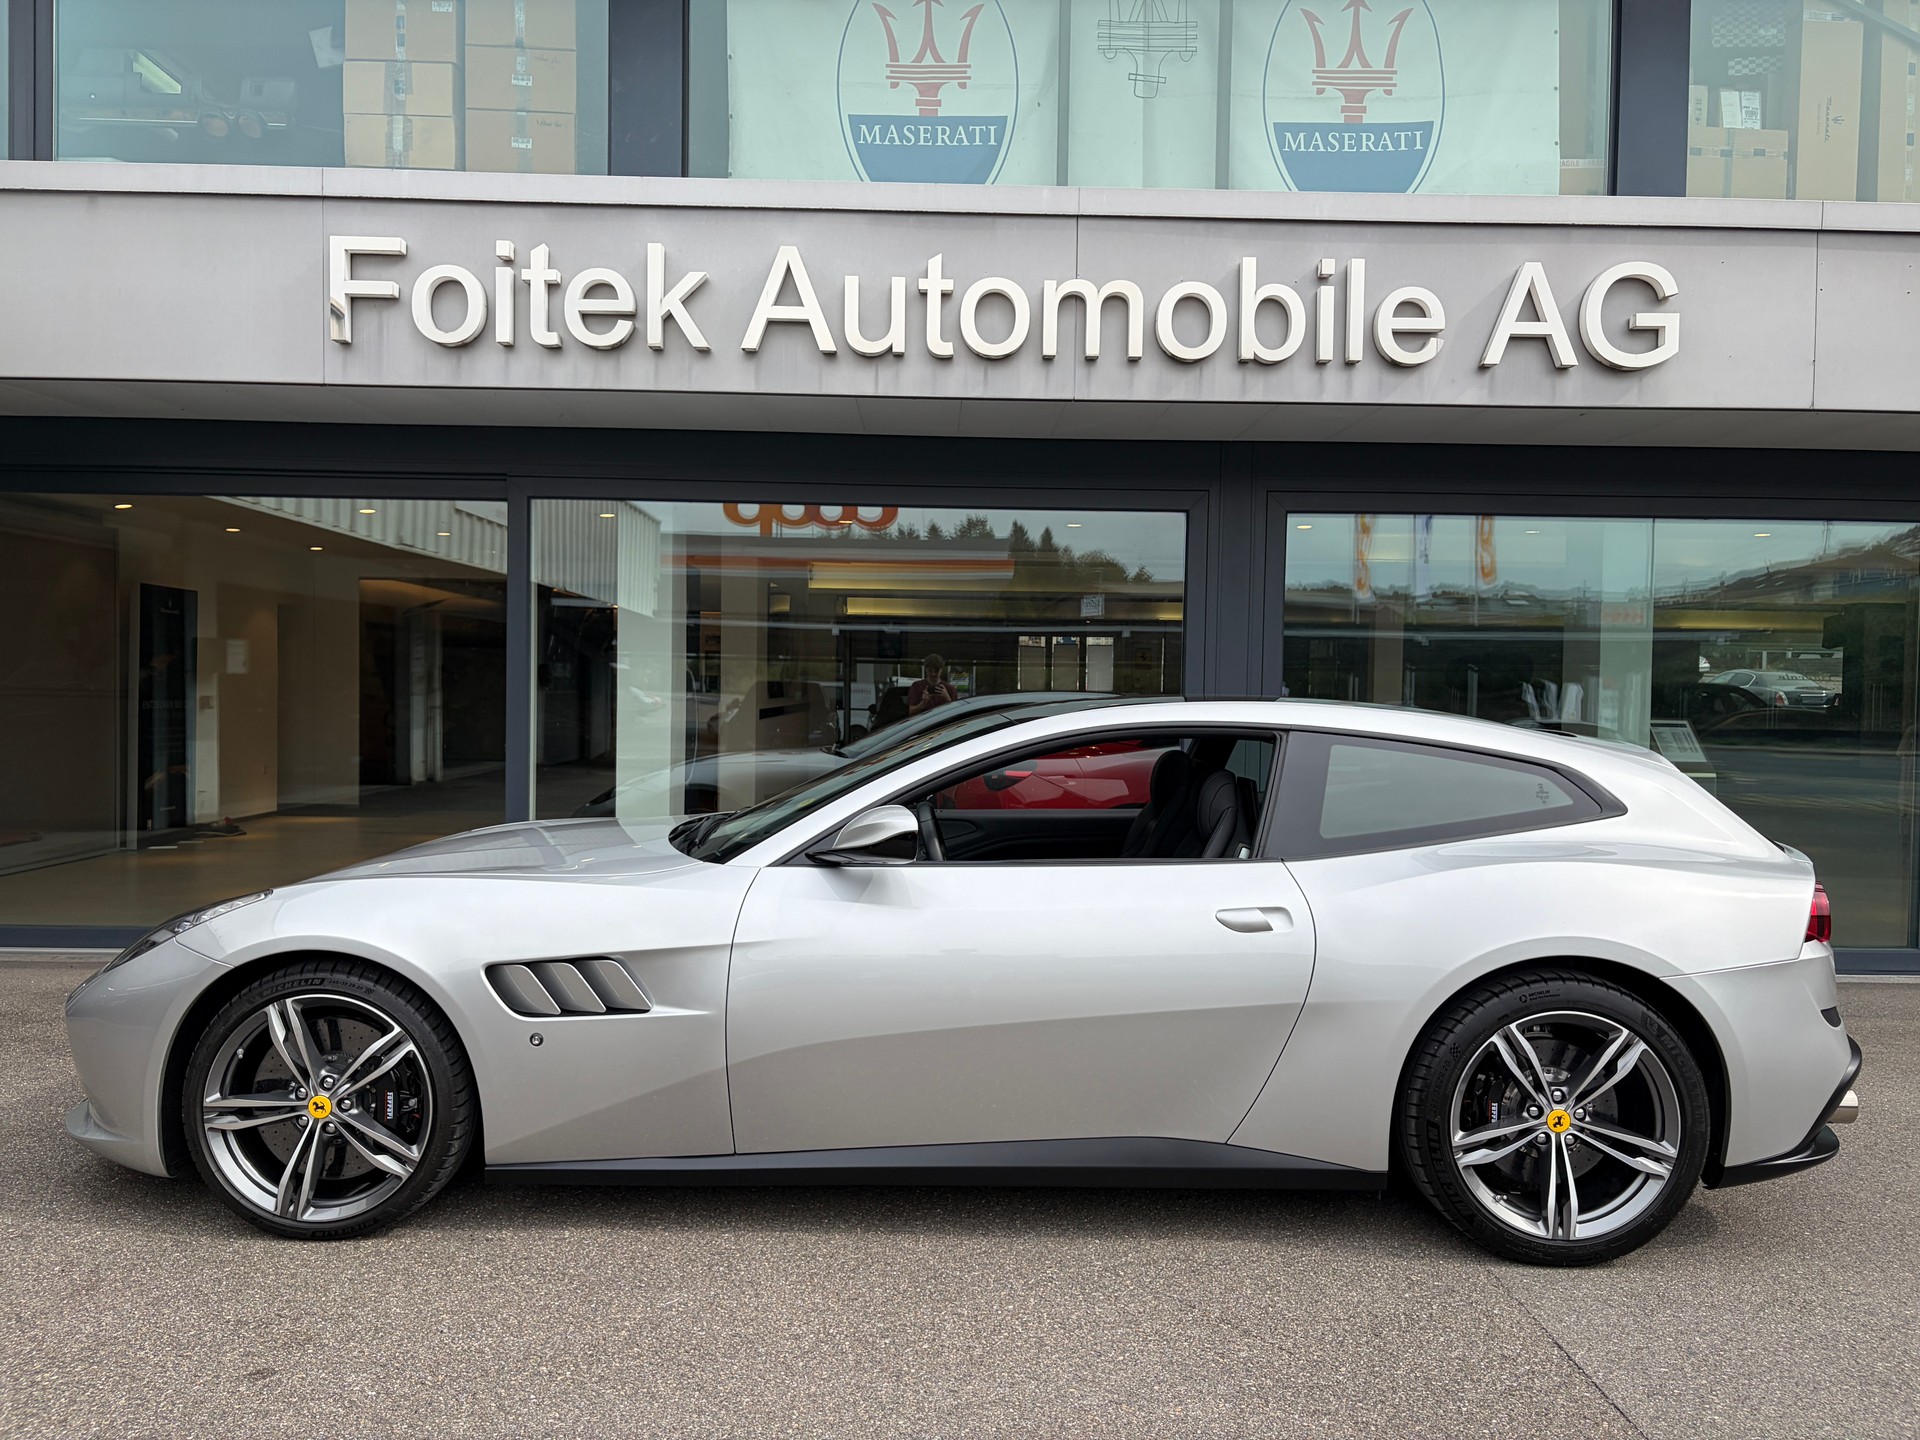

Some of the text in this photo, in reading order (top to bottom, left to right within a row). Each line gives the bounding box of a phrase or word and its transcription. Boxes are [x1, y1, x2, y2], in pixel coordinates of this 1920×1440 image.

[858, 125, 998, 146] MASERATI
[1282, 130, 1424, 152] MASERATI
[330, 235, 1681, 371] Foitek Automobile AG
[261, 978, 322, 997] MICHELIN
[1528, 989, 1551, 997] MICHELIN
[386, 1092, 394, 1120] Ferrari
[1424, 1125, 1476, 1218] MICHELIN
